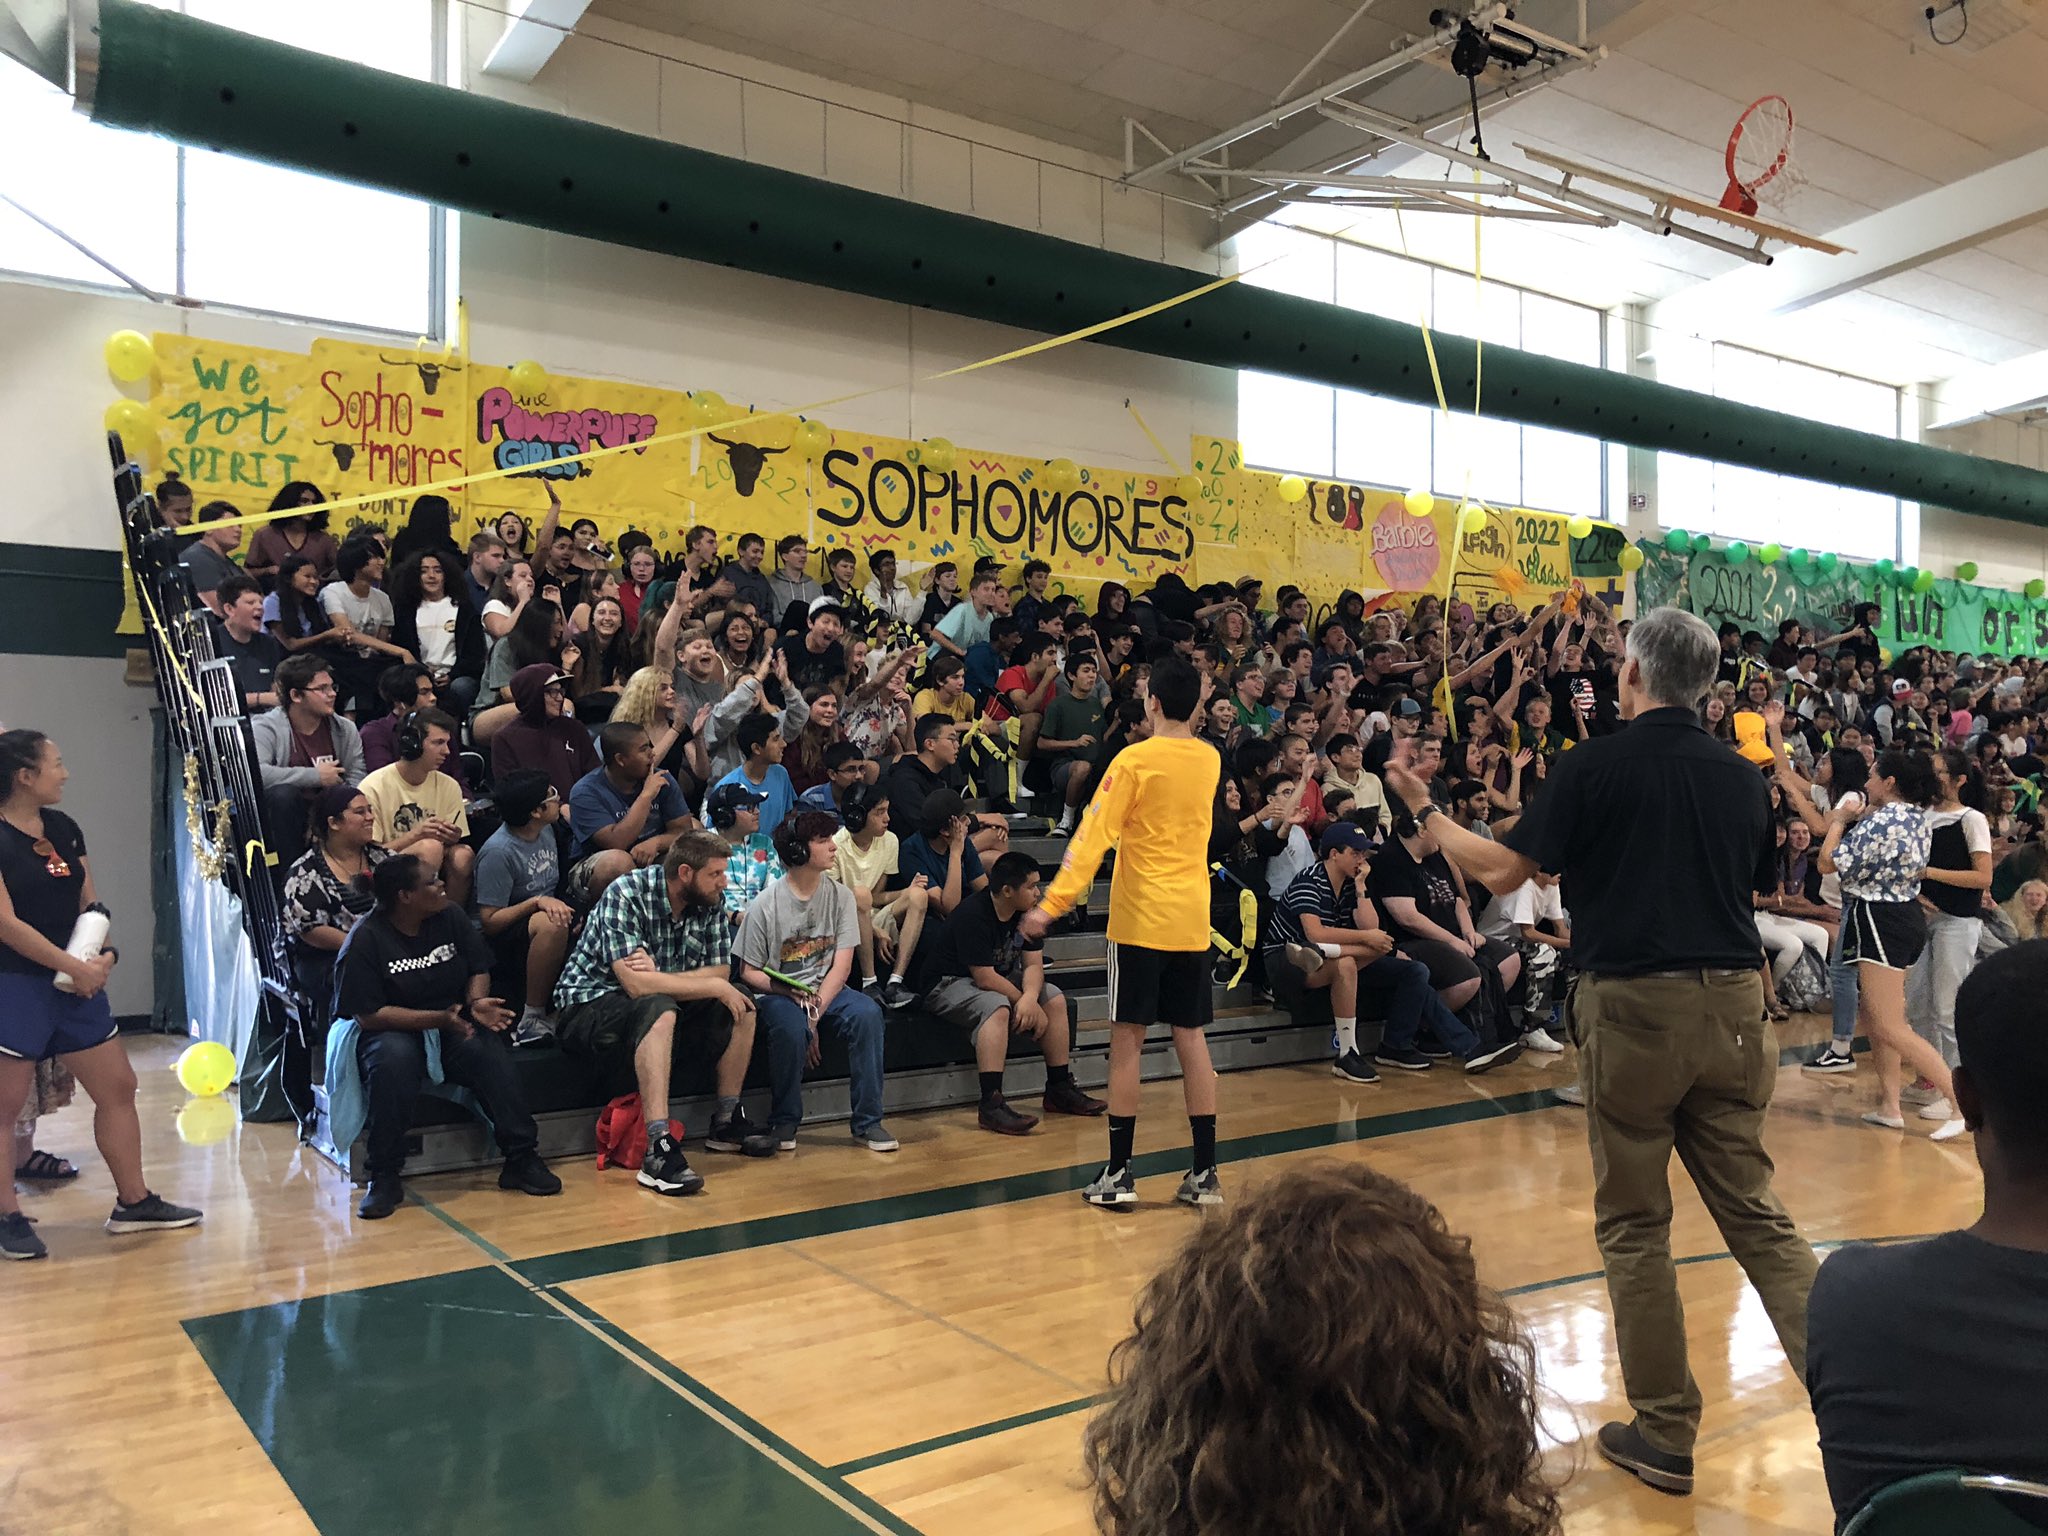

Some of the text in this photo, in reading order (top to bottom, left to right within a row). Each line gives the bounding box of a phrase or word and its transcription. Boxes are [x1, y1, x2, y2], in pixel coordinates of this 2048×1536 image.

[193, 357, 260, 395] We
[167, 396, 288, 445] got
[477, 387, 658, 455] POWERPUFF
[167, 446, 299, 488] SPIRIT
[369, 440, 463, 492] mores
[494, 440, 584, 481] GIRLS
[817, 449, 1194, 562] SOPHOMORES
[1371, 515, 1435, 558] Barbie
[1515, 516, 1561, 546] 2022
